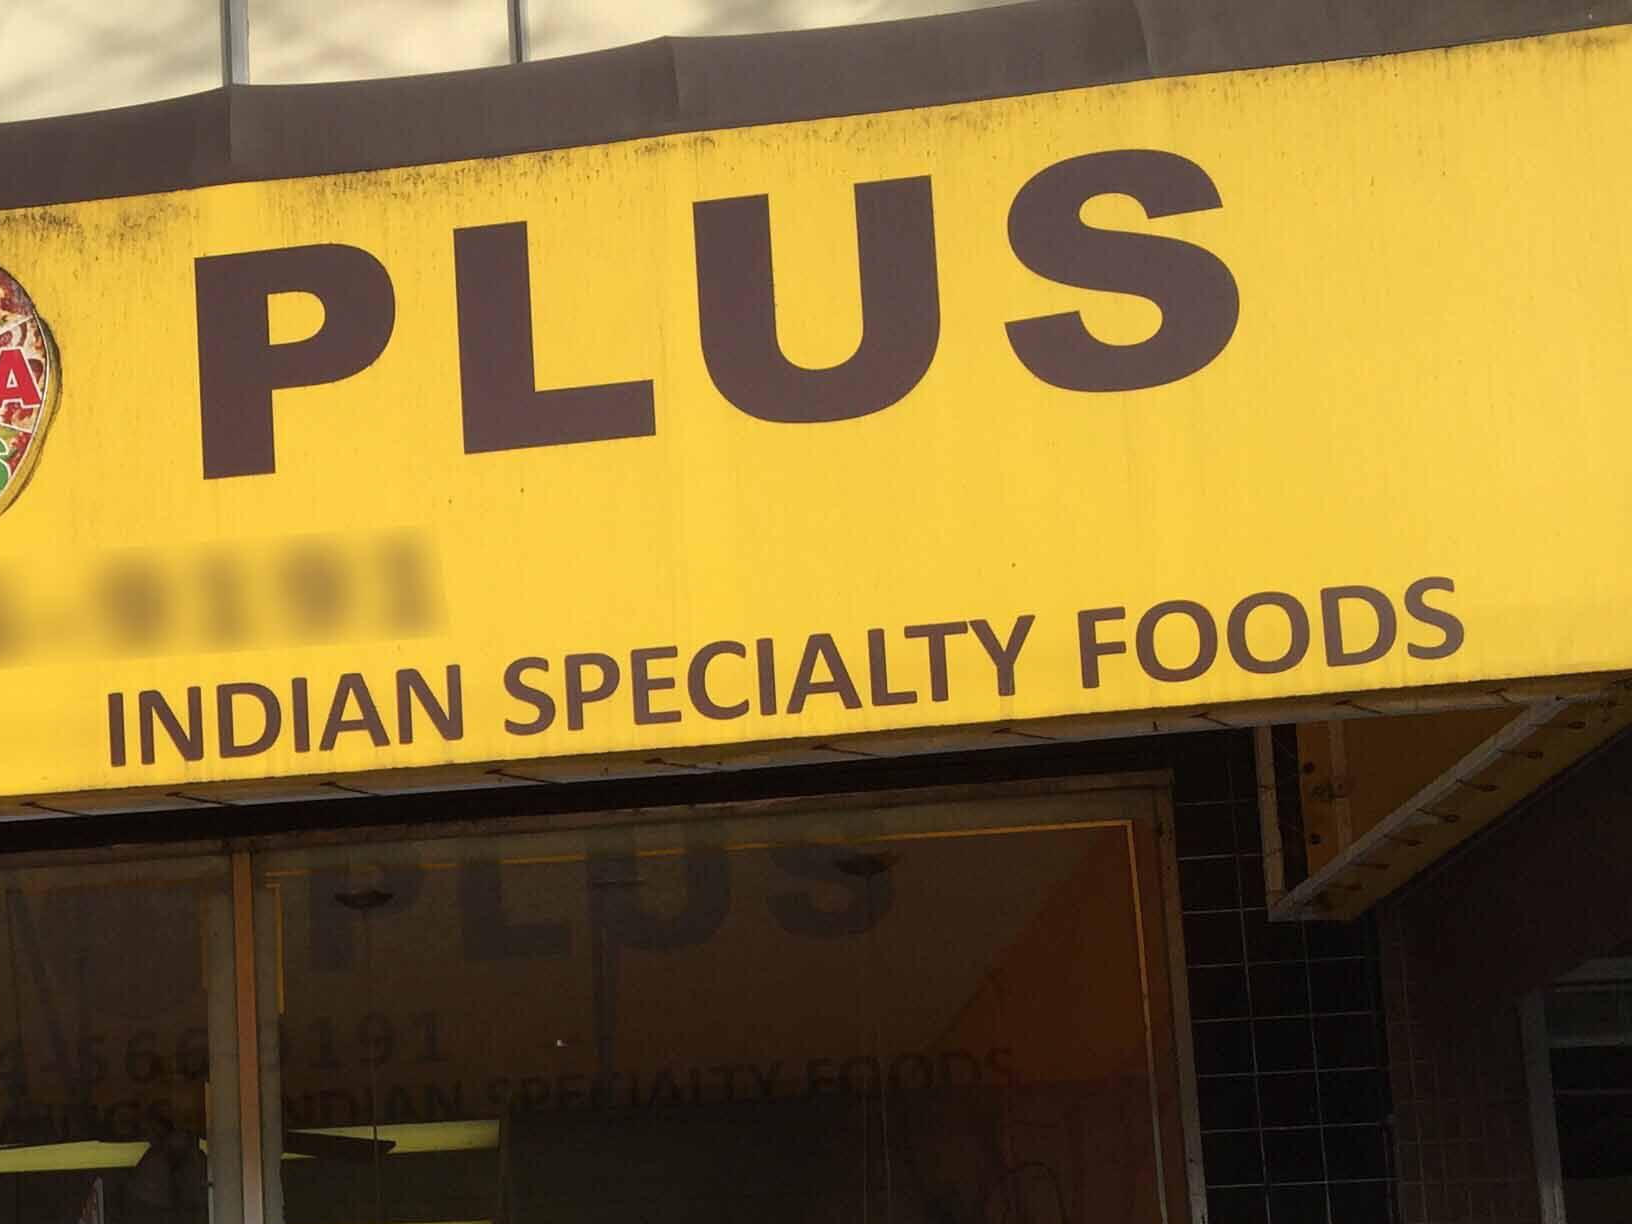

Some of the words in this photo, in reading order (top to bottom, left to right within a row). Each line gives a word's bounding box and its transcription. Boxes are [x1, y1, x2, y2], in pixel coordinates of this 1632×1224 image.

[193, 148, 1240, 481] PLUS
[107, 665, 466, 768] INDIAN
[502, 613, 1037, 739] SPECIALTY
[1076, 575, 1467, 692] FOODS
